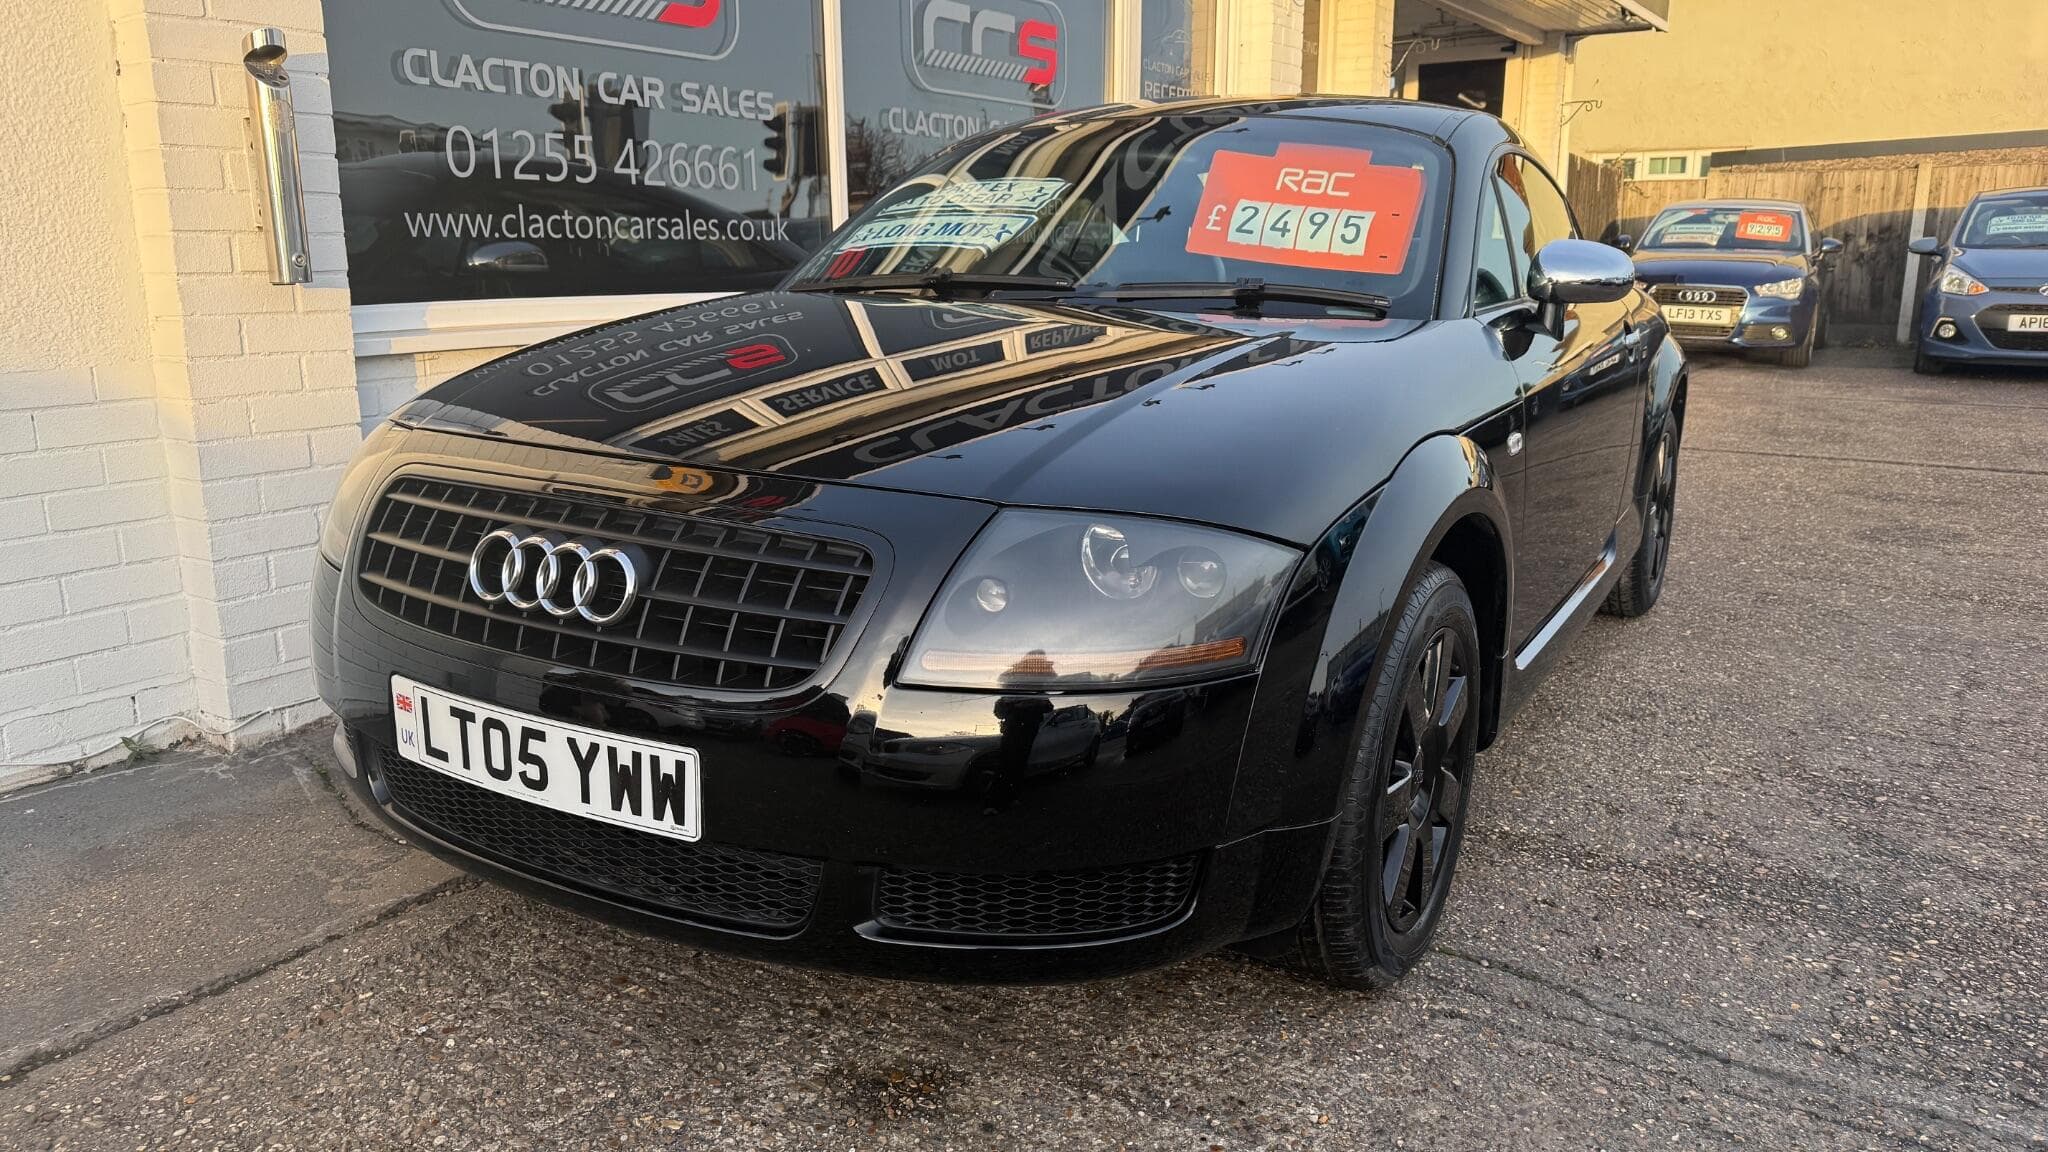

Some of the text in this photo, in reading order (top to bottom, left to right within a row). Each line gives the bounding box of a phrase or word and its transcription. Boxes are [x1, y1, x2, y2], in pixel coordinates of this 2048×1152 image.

[402, 47, 775, 121] CLACTON CAR SALES
[888, 106, 980, 140] CLACTON
[445, 124, 758, 192] 01255 426661
[403, 203, 790, 242] www.clactoncarsales.co.uk
[873, 222, 990, 239] LONG MOT
[1668, 308, 1722, 321] LF13 TXS
[400, 729, 416, 748] UK
[420, 695, 686, 827] LT05 YWW
